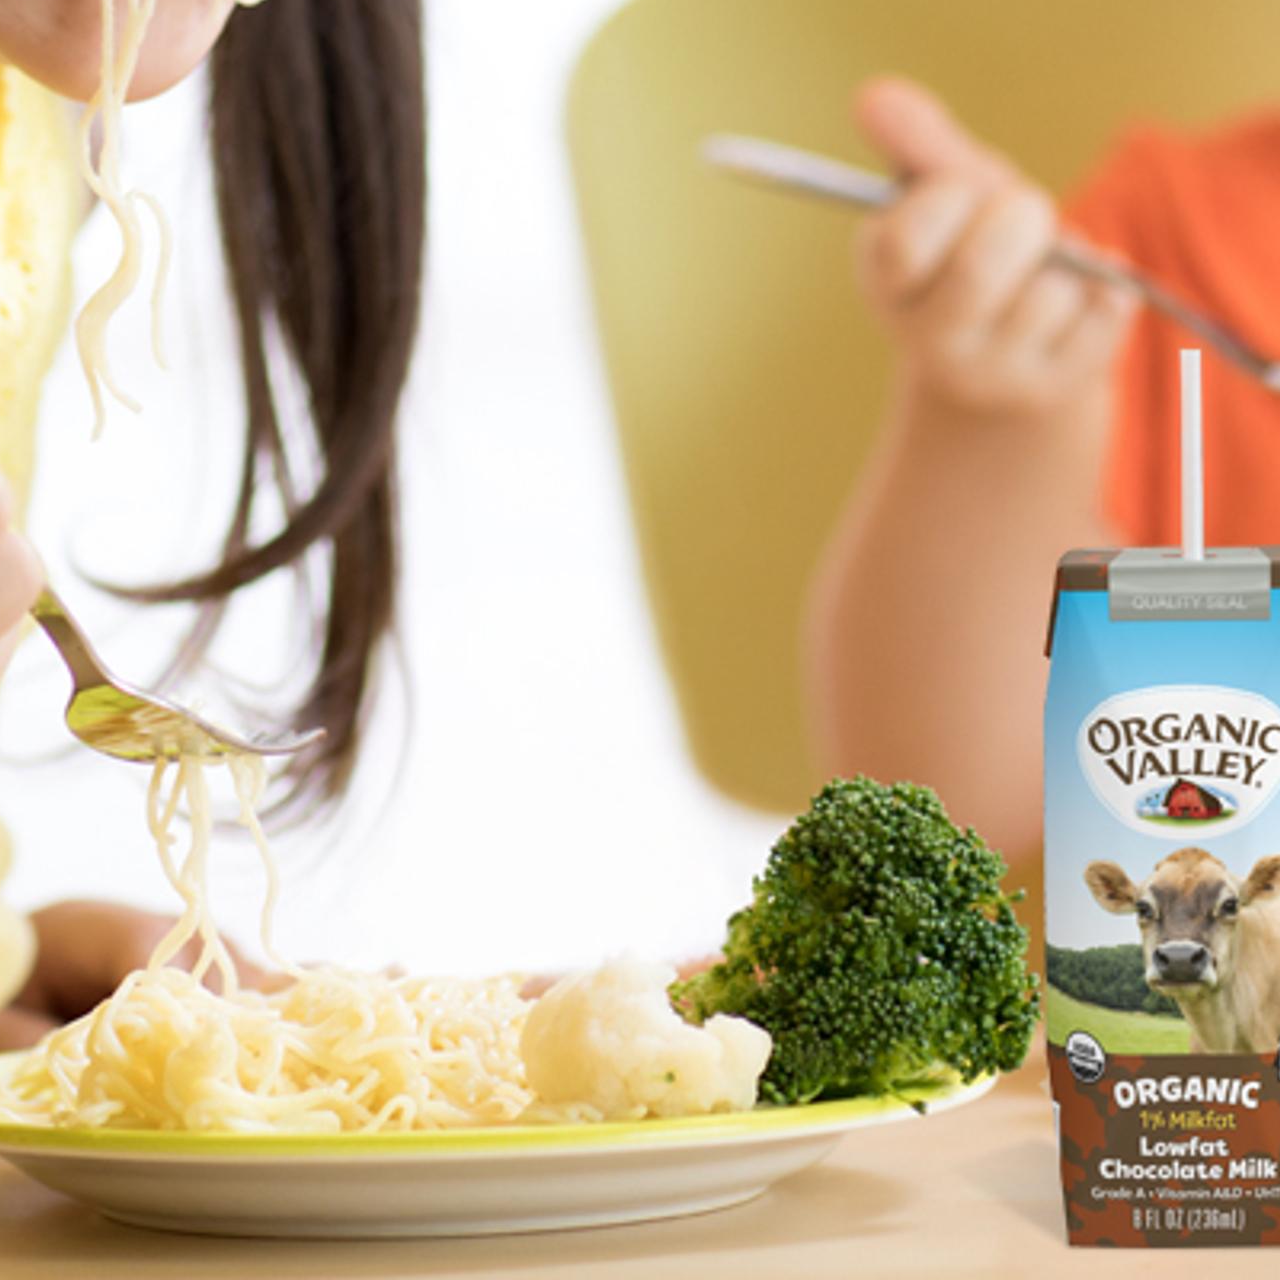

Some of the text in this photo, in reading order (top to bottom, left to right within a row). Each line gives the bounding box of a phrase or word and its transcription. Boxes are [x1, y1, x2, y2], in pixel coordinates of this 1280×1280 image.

[1105, 748, 1267, 786] VALLEY
[1113, 1076, 1261, 1108] ORGANIC
[1139, 1110, 1237, 1129] 1% Milkfat
[1139, 1136, 1228, 1156] Lowfat
[1099, 1158, 1278, 1179] Chocolate Milk
